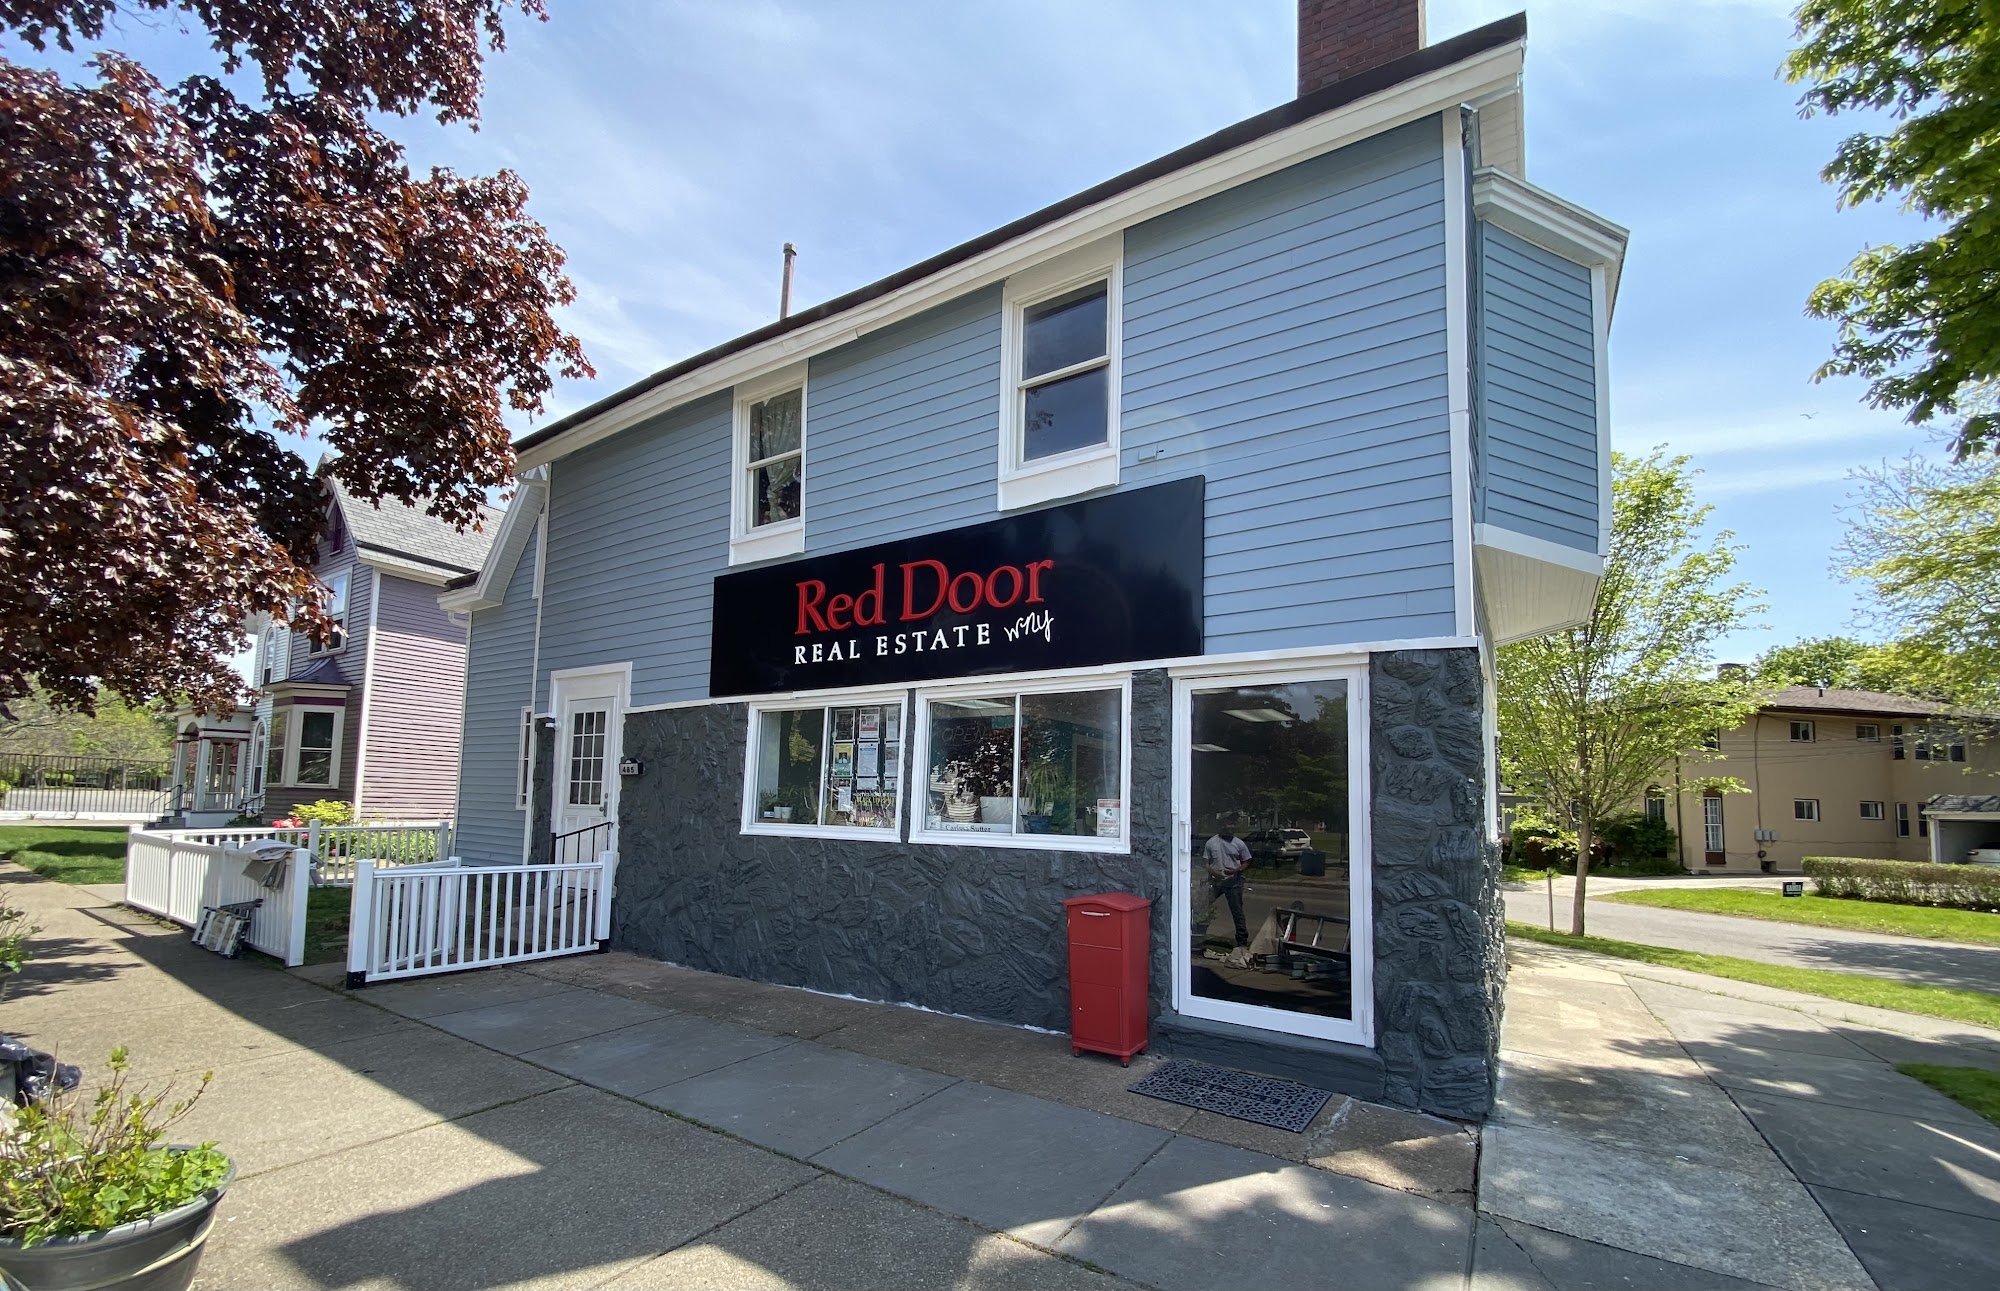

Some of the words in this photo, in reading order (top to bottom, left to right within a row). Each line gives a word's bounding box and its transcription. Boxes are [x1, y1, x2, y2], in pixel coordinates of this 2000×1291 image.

[794, 563, 887, 635] Red
[899, 558, 1054, 622] Door
[794, 639, 861, 665] REAL
[876, 623, 991, 656] ESTATE
[941, 725, 987, 743] OPEN
